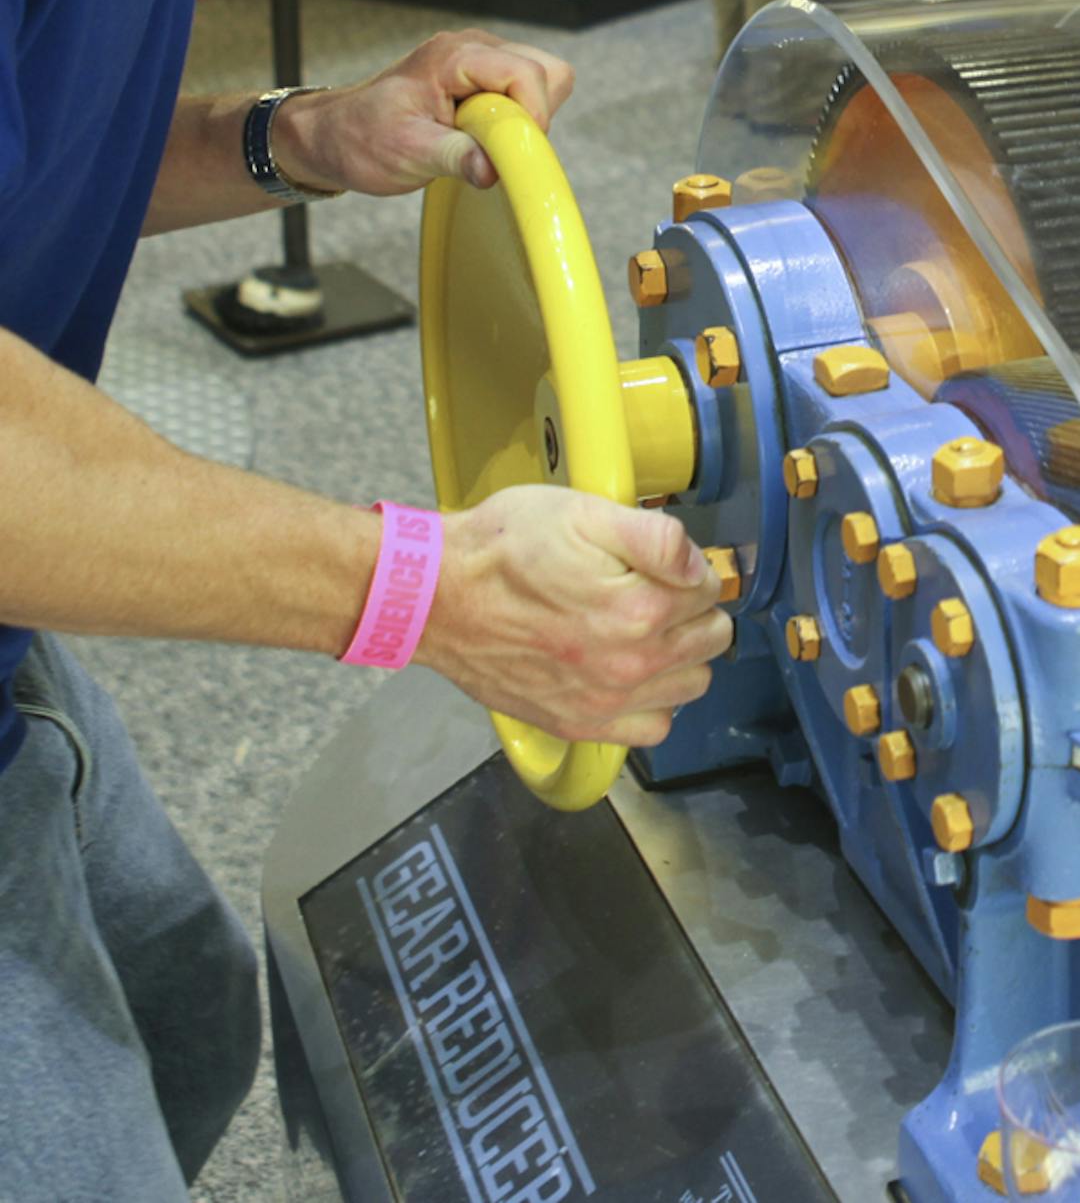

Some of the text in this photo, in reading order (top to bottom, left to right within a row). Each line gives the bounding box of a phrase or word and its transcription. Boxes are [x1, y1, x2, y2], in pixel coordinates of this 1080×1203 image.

[361, 514, 431, 662] SCIENCE IS
[373, 840, 573, 1203] GEAR REDUCER
